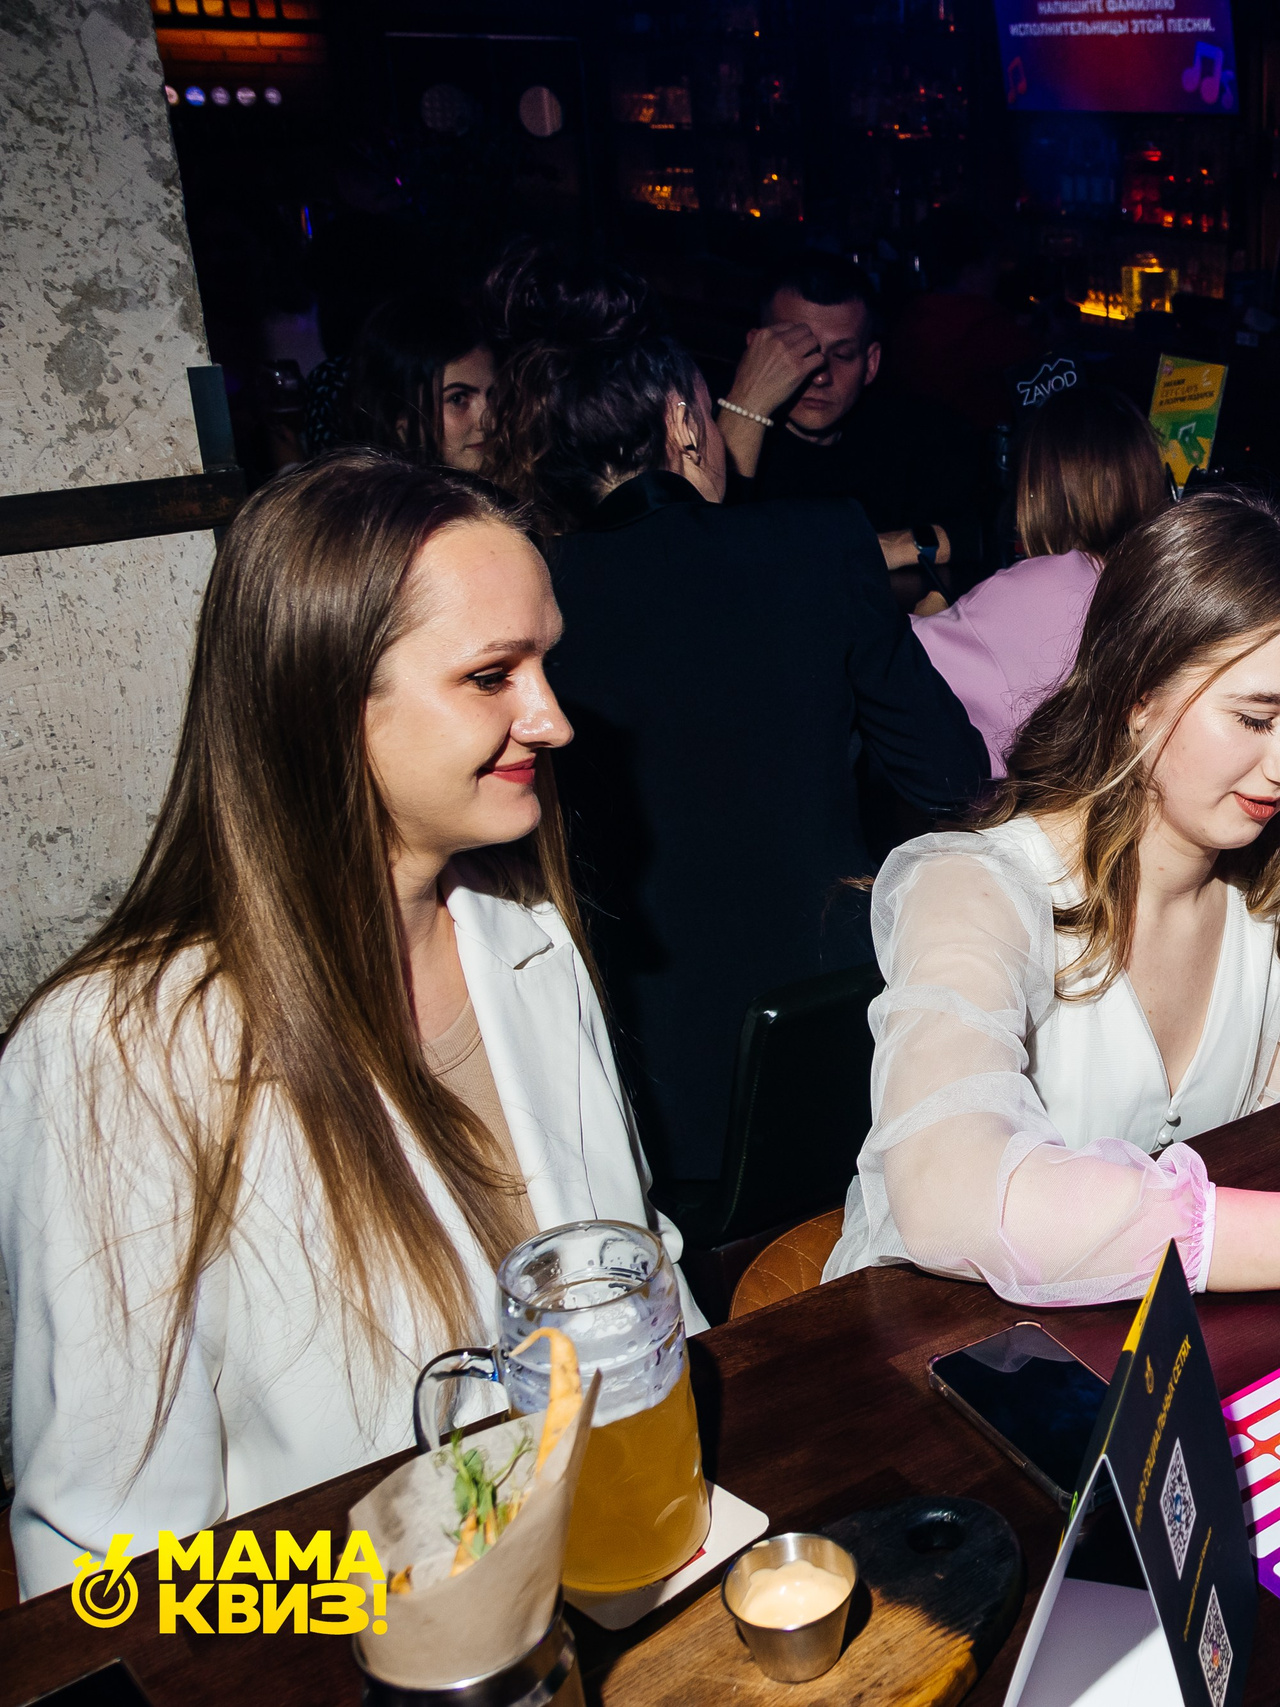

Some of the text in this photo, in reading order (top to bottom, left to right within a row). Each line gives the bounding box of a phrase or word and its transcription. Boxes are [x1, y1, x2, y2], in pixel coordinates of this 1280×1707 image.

[1009, 13, 1215, 37] ИСПОЛНИТЕЛЬНИЦЫ ЭТОЙ ПЕСНИ.
[1020, 371, 1077, 406] ZAVOD
[1143, 1381, 1176, 1486] СОЦИАЛЬНЫХ
[1172, 1334, 1192, 1385] СЕТЯХ
